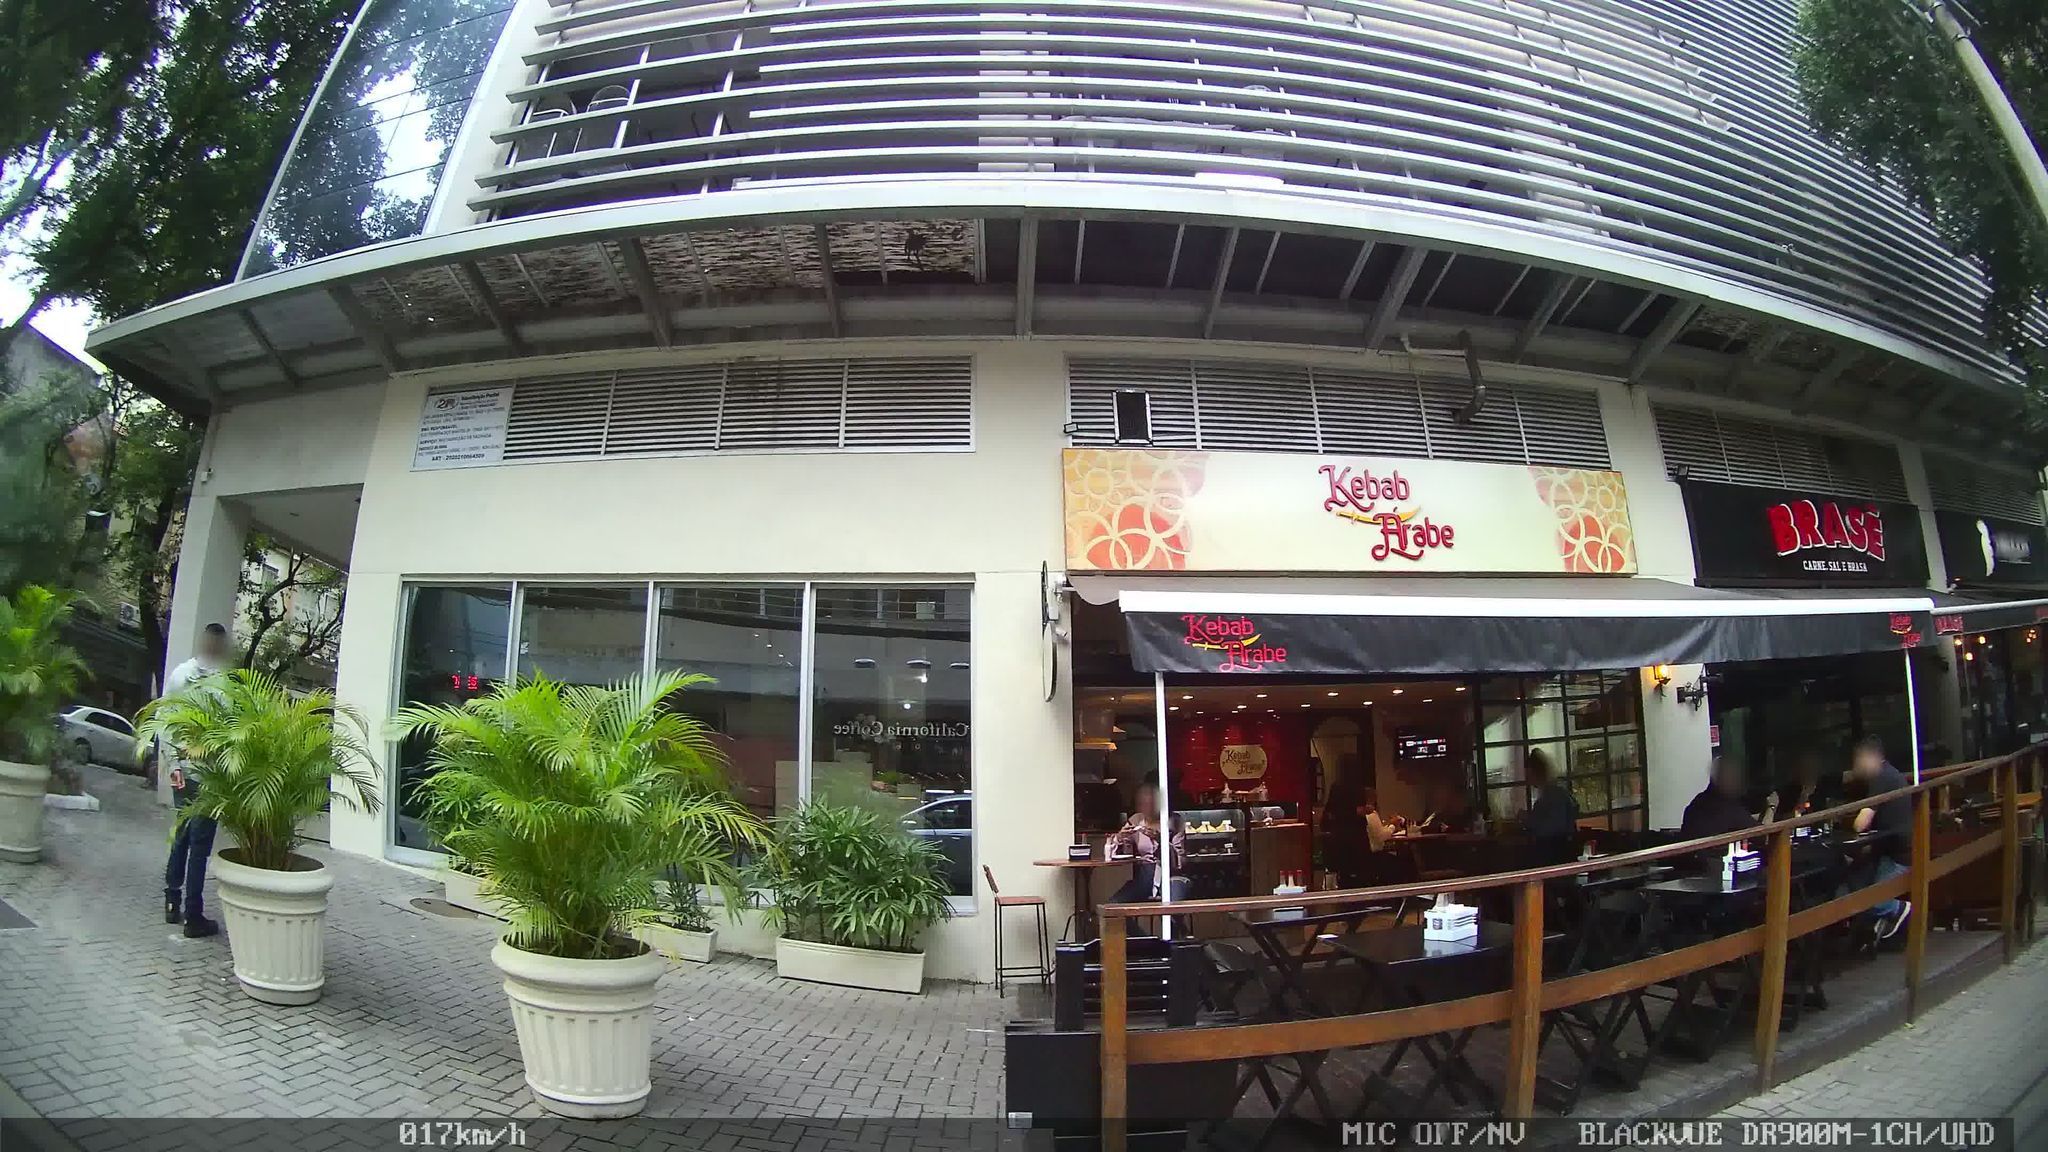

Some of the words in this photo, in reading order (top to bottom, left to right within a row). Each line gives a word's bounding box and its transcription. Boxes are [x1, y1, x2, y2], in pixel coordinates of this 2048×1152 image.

[1318, 464, 1410, 512] Kebab
[1842, 561, 1847, 571] E
[1181, 614, 1255, 645] Kebab
